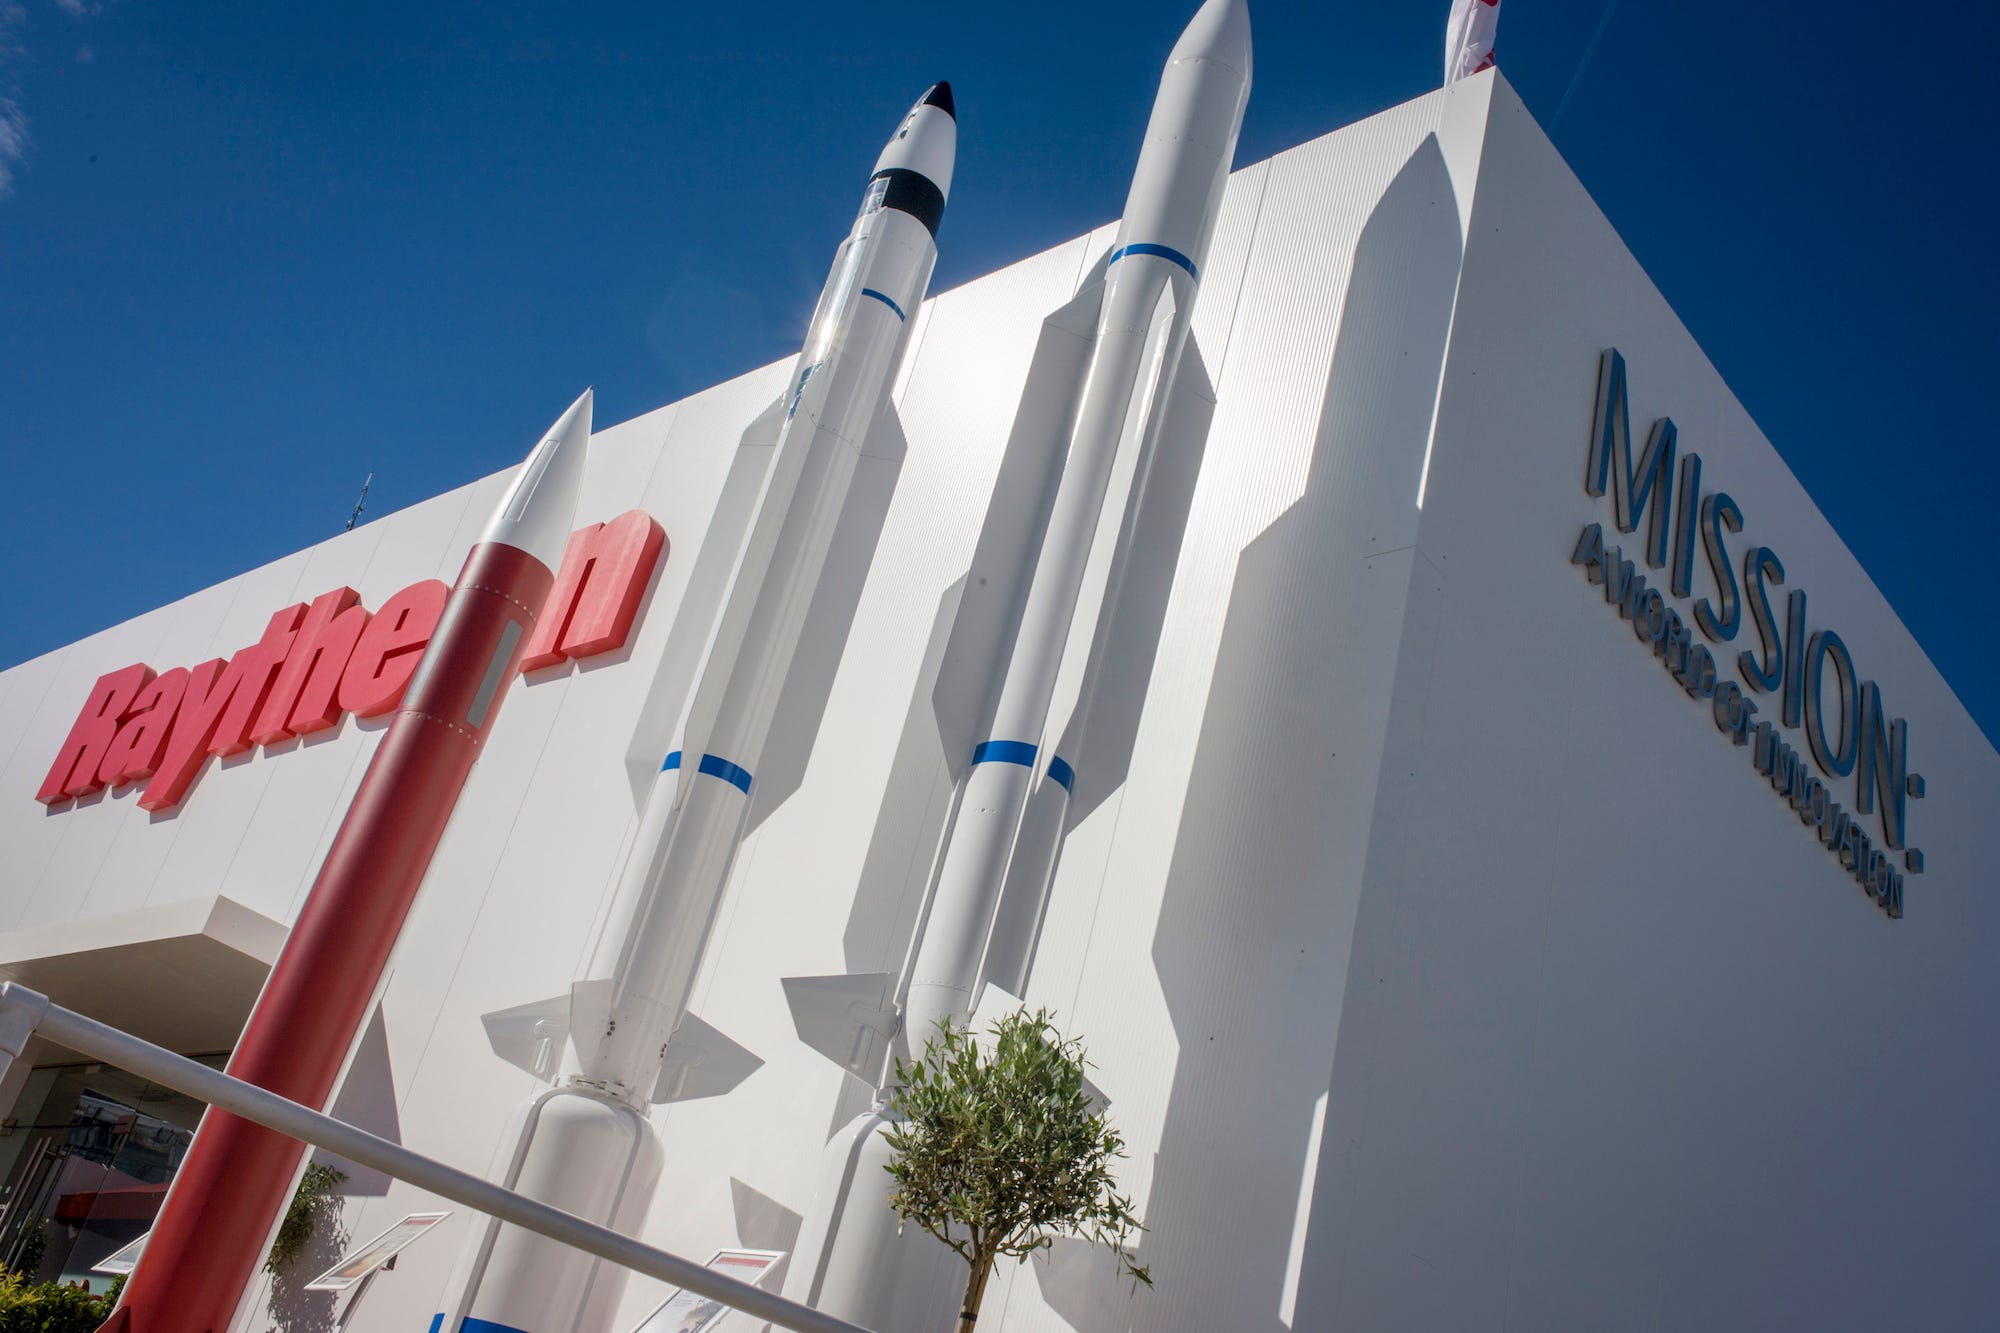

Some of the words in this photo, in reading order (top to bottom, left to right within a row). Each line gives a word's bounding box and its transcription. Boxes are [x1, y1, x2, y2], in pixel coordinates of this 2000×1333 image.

[35, 509, 666, 812] Raythen
[1571, 522, 1605, 585] A
[1605, 545, 1717, 699] WORLD
[1713, 680, 1759, 746] OF
[1753, 720, 1904, 920] INNOVATION
[1585, 346, 1926, 875] MISSION:
